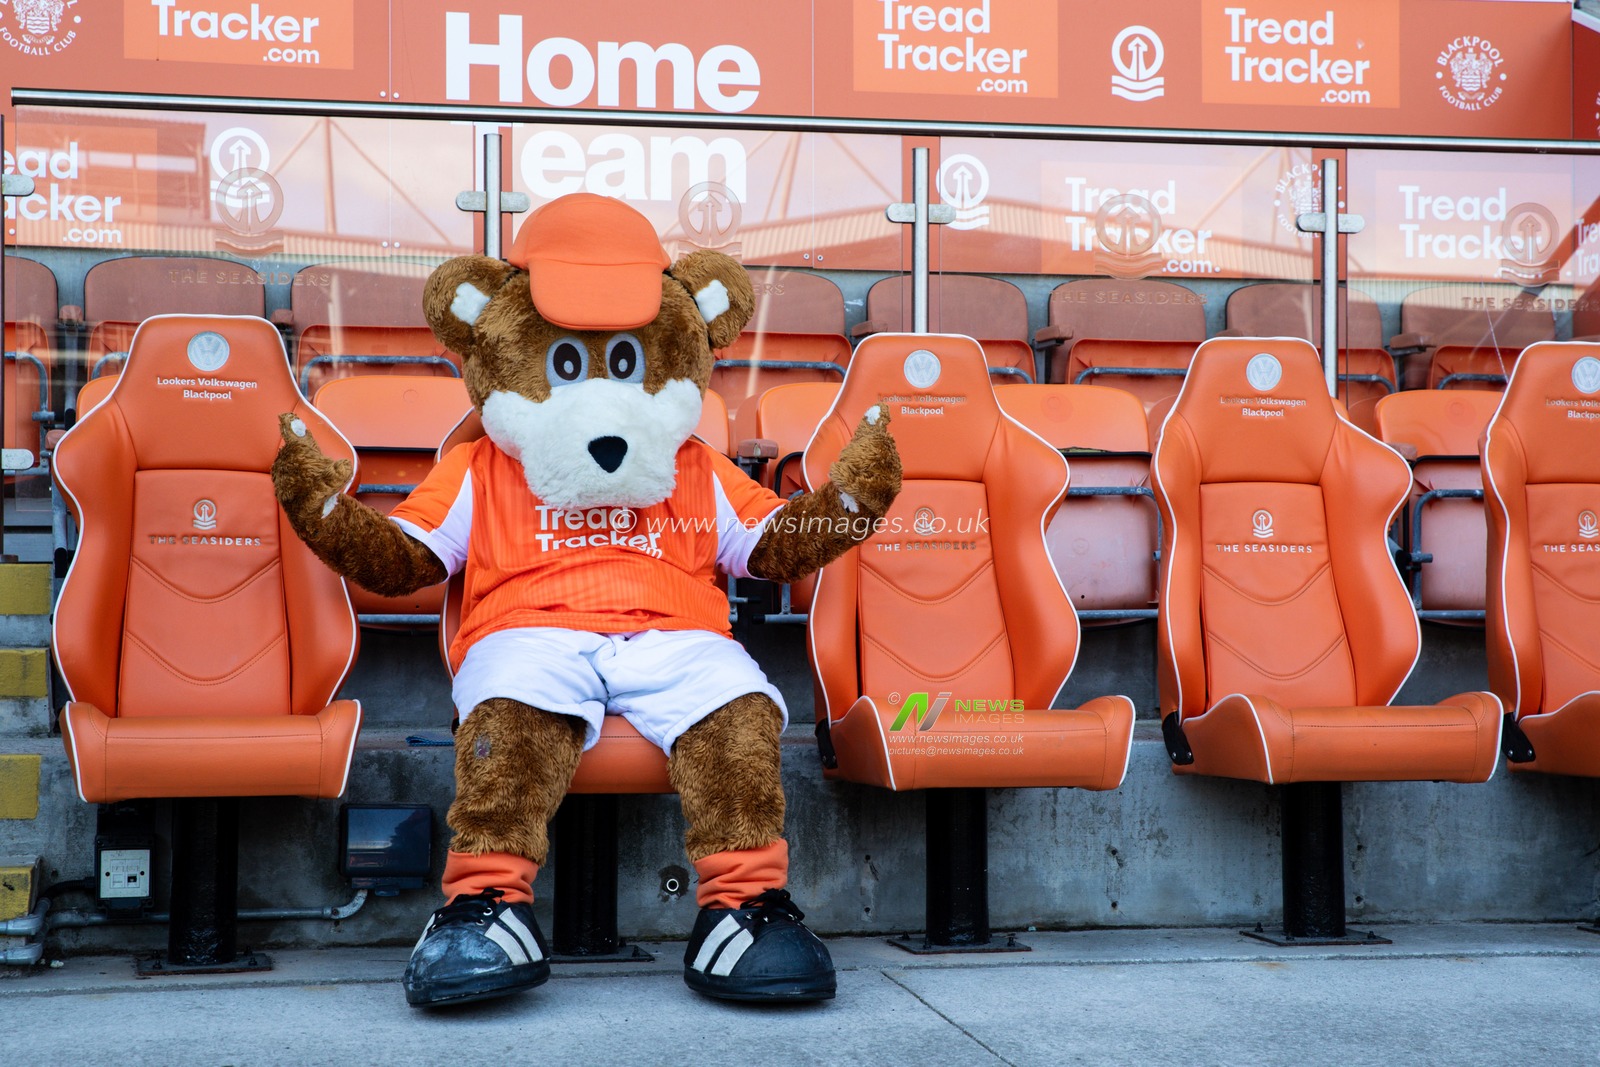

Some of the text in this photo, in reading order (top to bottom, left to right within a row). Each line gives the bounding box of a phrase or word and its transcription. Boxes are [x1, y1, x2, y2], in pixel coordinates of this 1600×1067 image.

[155, 0, 319, 43] Tracker
[877, 0, 990, 33] Tread
[1225, 8, 1334, 45] Tread
[0, 27, 50, 55] FOOTBALL
[54, 30, 76, 52] CLUB
[263, 47, 320, 64] .com
[877, 33, 1027, 74] Tracker
[1436, 36, 1504, 66] BLACKPOOL
[446, 11, 761, 113] Home
[1225, 46, 1370, 85] Tracker
[976, 78, 1028, 93] .com
[1320, 88, 1370, 104] .com
[1439, 85, 1503, 111] FOOTBALL CLUB
[1065, 177, 1176, 215] Tread
[1398, 185, 1506, 221] Tread
[63, 228, 121, 243] .com
[1162, 259, 1212, 273] .com
[169, 271, 331, 286] THE SEASIDERS
[1095, 291, 1208, 305] SEASIDERS
[1462, 296, 1496, 309] THE
[157, 377, 258, 389] Lookers Volkswagen
[183, 389, 232, 400] Blackpool
[1256, 397, 1307, 408] Volkswagen
[1545, 398, 1579, 407] Lookers
[901, 406, 944, 417] Blackpool
[1242, 408, 1284, 418] Blackpool
[535, 505, 631, 531] Tread
[149, 536, 262, 546] THE SEASIDERS
[535, 531, 661, 552] Tracker
[877, 542, 977, 552] THE SEASIDERS
[1216, 544, 1313, 553] THE SEASIDERS
[1543, 544, 1566, 553] THE
